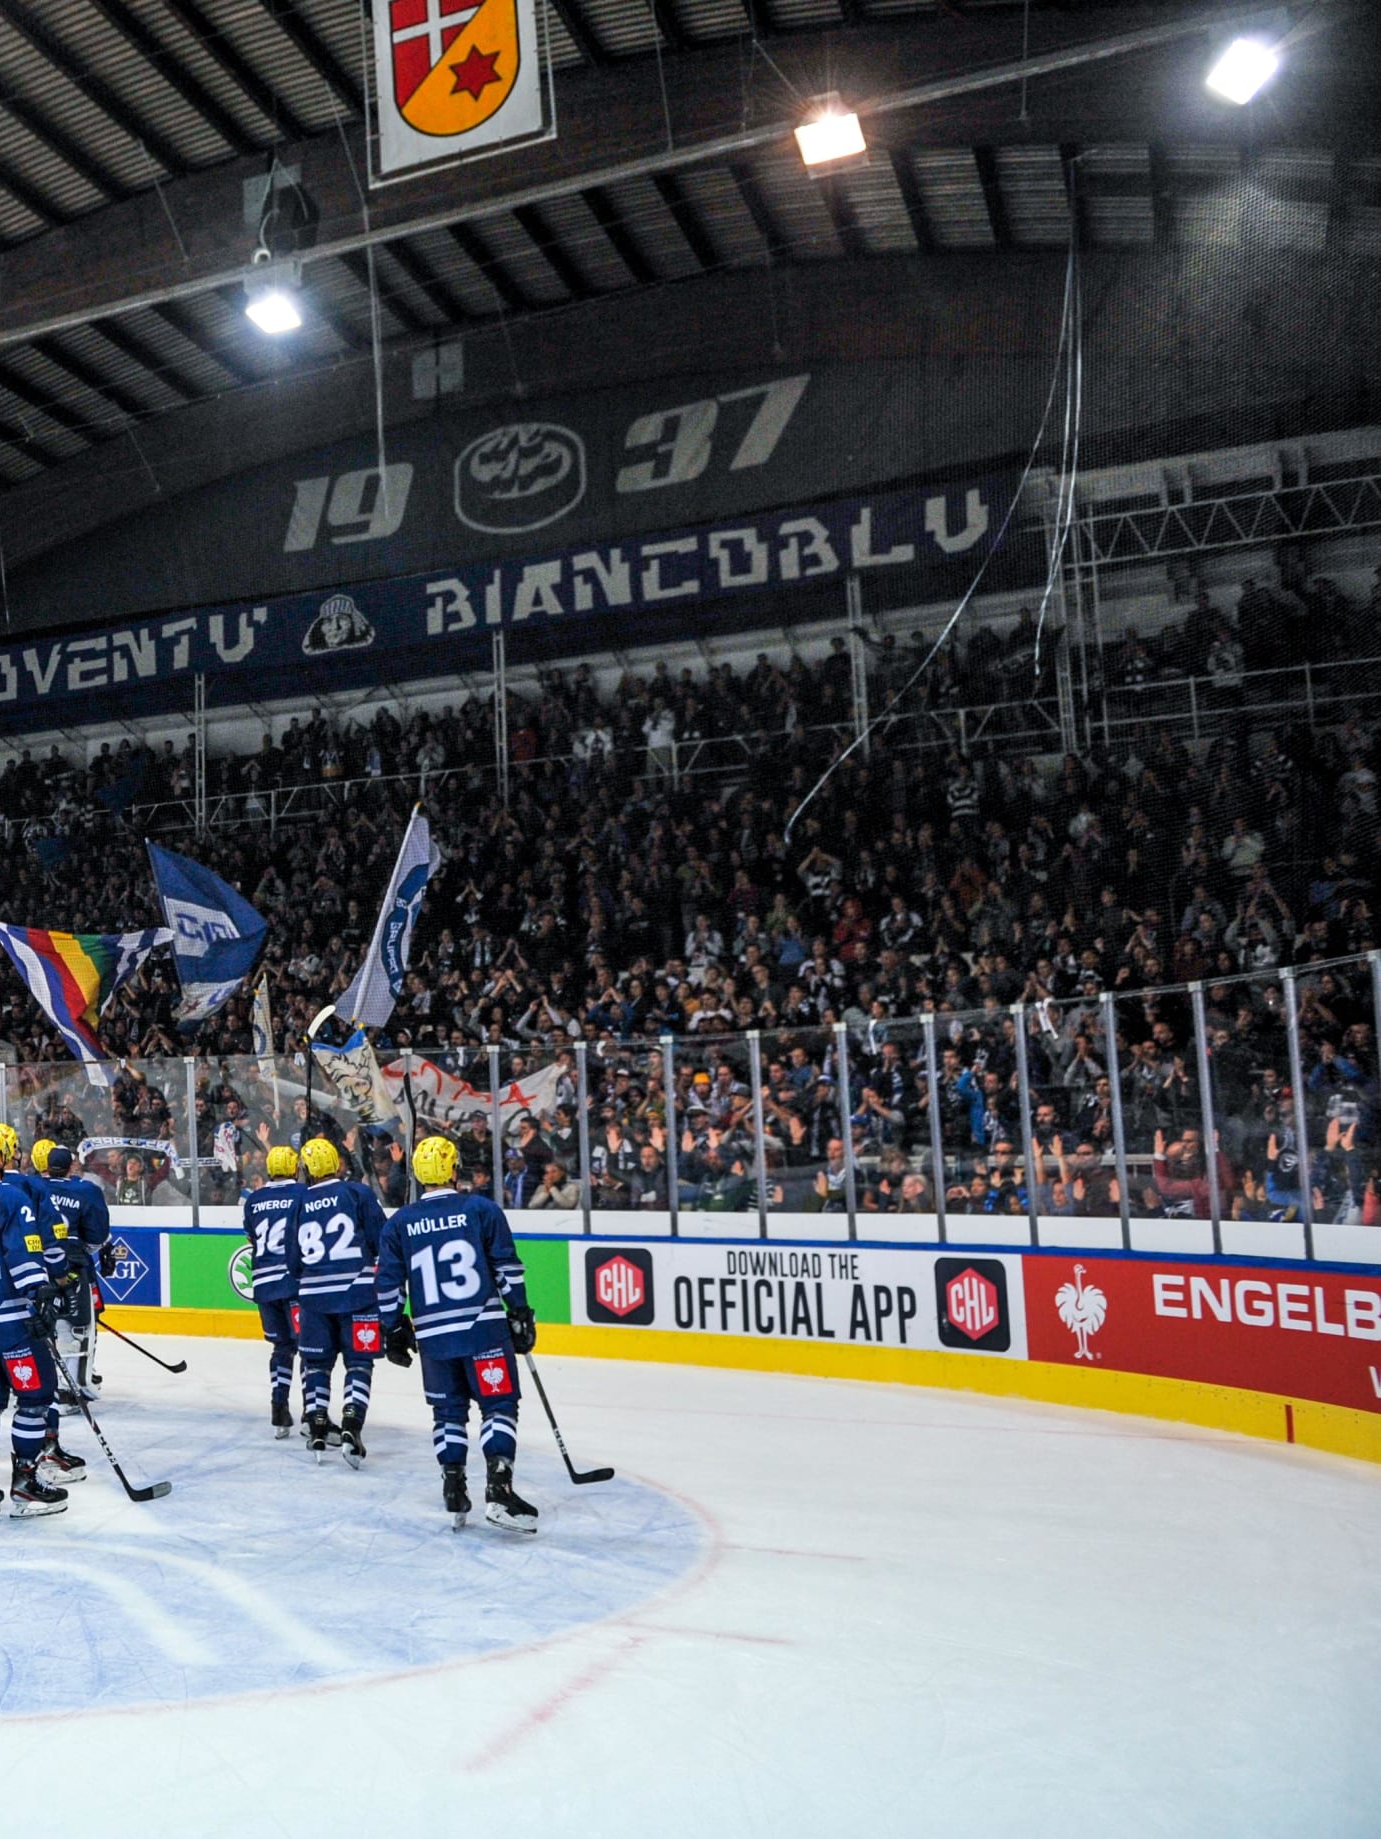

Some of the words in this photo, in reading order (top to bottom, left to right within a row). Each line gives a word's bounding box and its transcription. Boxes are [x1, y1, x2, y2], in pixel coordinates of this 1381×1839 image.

[283, 462, 414, 553] 19
[616, 374, 812, 493] 37
[427, 489, 989, 635] BIANCOBLU
[304, 1196, 338, 1213] NGOY
[406, 1213, 468, 1237] MÜLLER
[298, 1213, 363, 1265] 82
[727, 1250, 822, 1279] DOWNLOAD
[828, 1253, 860, 1280] THE
[105, 1261, 140, 1279] GT
[411, 1239, 480, 1306] 13
[599, 1263, 641, 1309] CHL
[674, 1276, 835, 1338] OFFICIAL
[849, 1283, 917, 1343] APP
[950, 1276, 995, 1331] CHL
[1152, 1273, 1381, 1341] ENGELB
